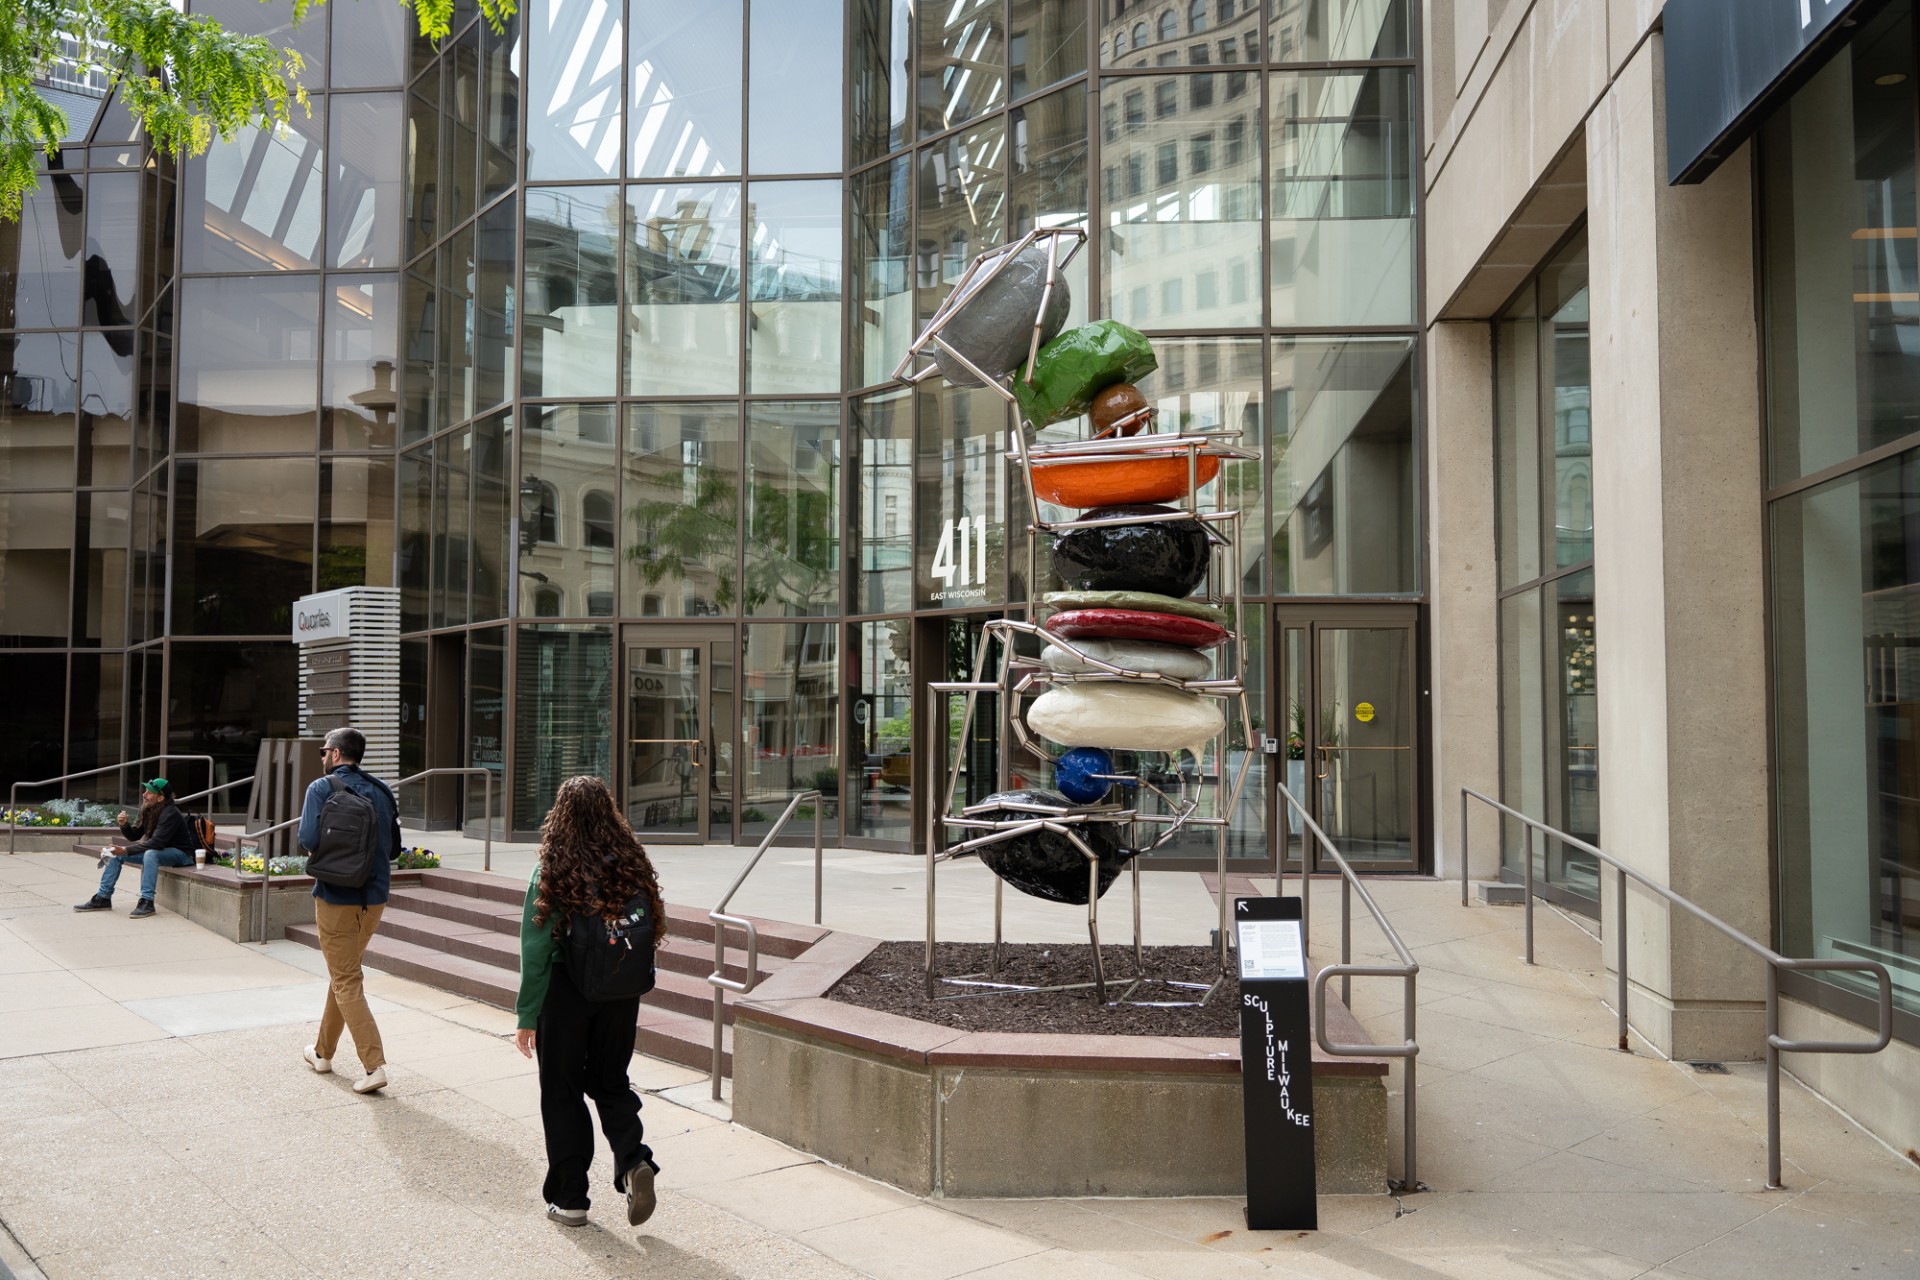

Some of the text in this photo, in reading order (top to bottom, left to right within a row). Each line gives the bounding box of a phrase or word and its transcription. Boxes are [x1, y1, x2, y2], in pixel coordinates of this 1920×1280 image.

[931, 514, 986, 588] 411
[298, 609, 331, 631] Quarles
[930, 588, 986, 600] EAST WISCONSIN
[246, 739, 301, 857] 411
[1244, 994, 1275, 1080] SCULPTURE
[1278, 1040, 1310, 1126] MILWAUKEE
